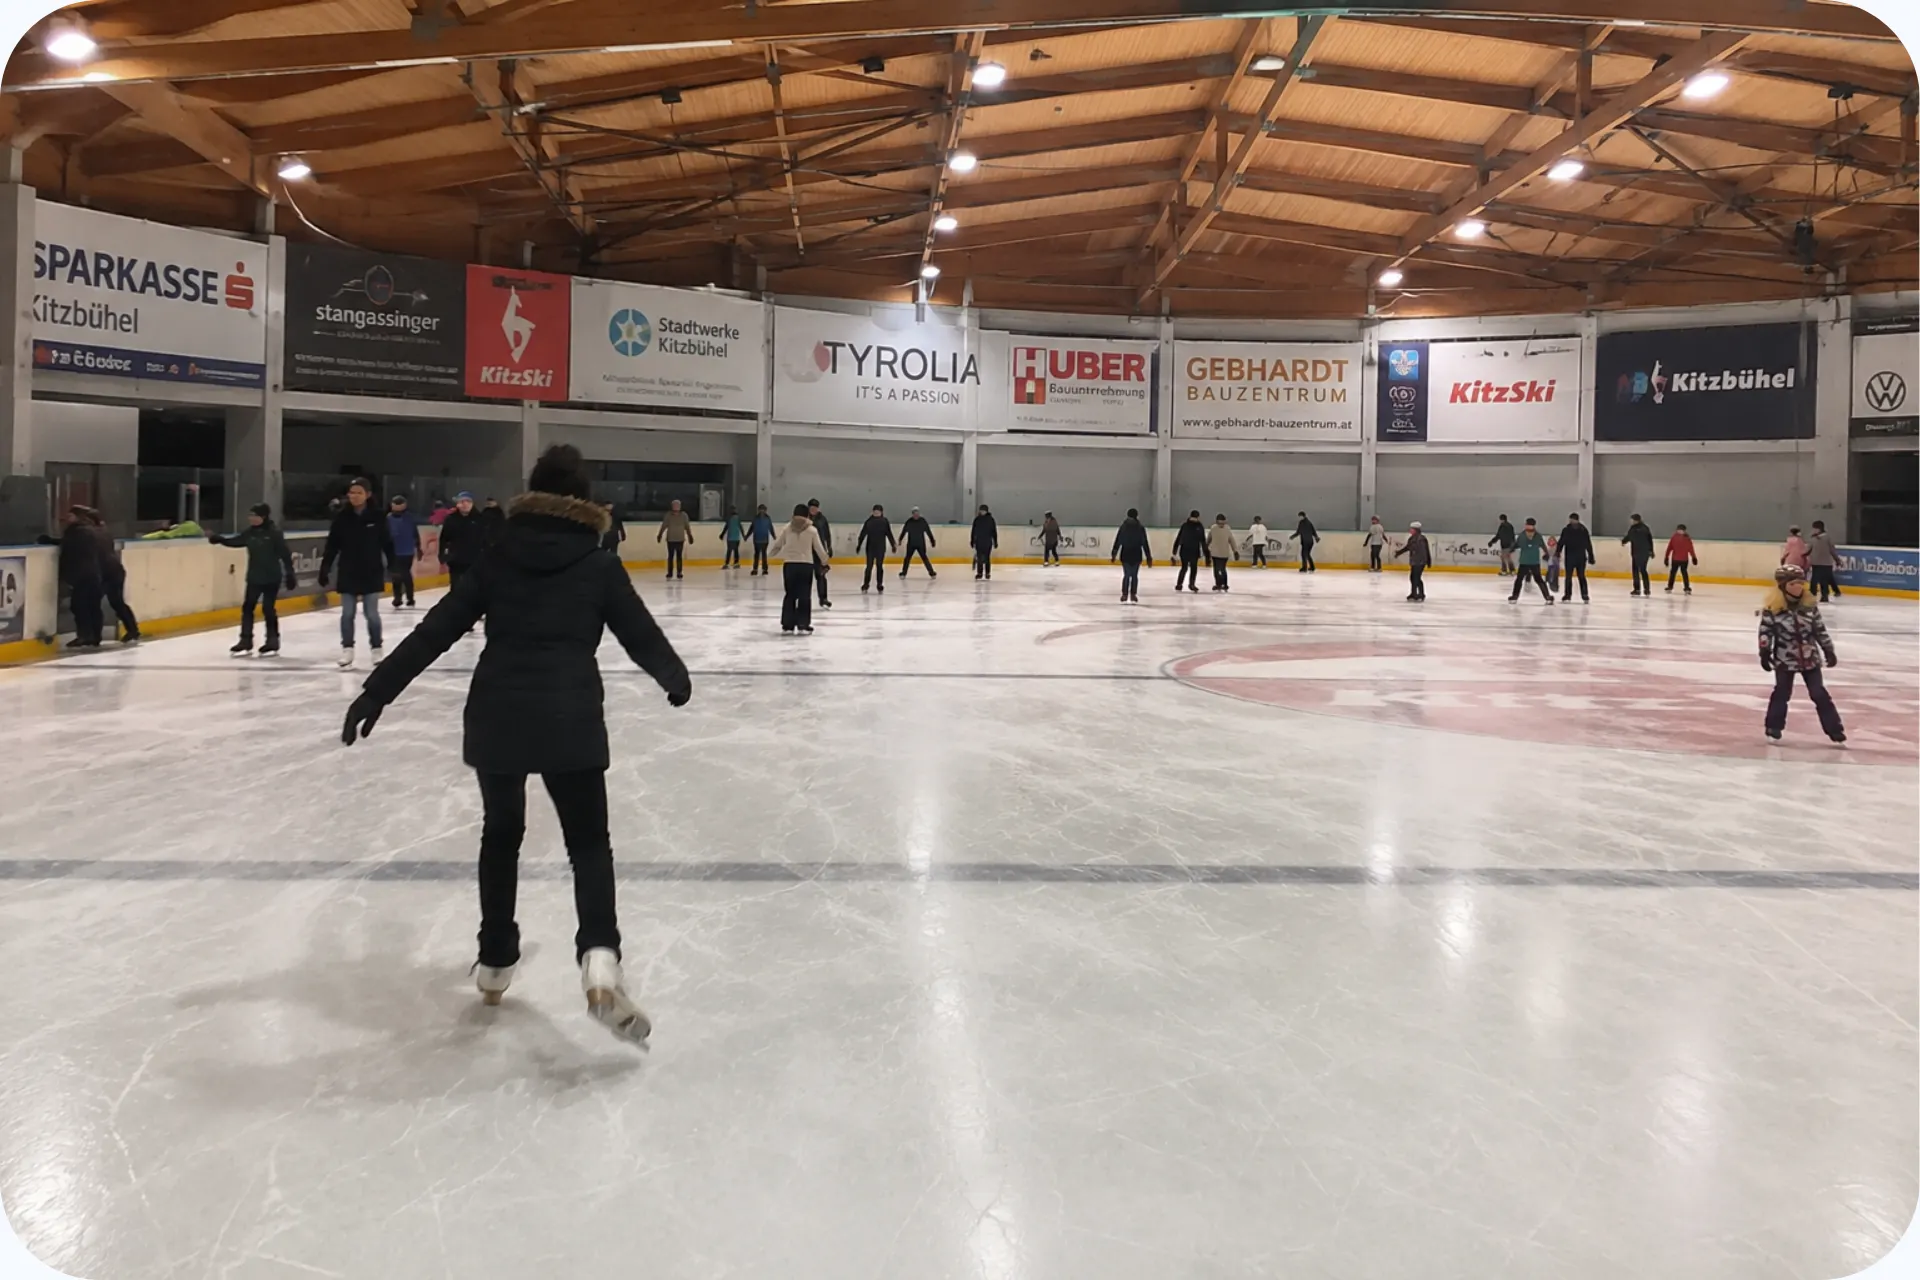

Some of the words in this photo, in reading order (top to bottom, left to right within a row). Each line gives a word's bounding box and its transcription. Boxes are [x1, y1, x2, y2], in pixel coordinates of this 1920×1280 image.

[315, 304, 440, 334] stangassinger
[658, 317, 740, 340] Stadtwerke
[658, 337, 728, 358] Kitzbühel
[823, 341, 981, 385] TYROLIA
[1013, 347, 1145, 382] HUBER
[1186, 357, 1349, 383] GEBHARDT
[480, 366, 554, 388] KitzSki
[1671, 368, 1795, 392] Kitzbühel
[856, 385, 883, 400] IT'S
[888, 388, 898, 401] A
[902, 388, 960, 404] PASSION
[1187, 386, 1347, 403] BAUZENTRUM
[1449, 379, 1556, 404] KitzSki
[1182, 417, 1352, 430] www.gebhardt-bauzentrum.at
